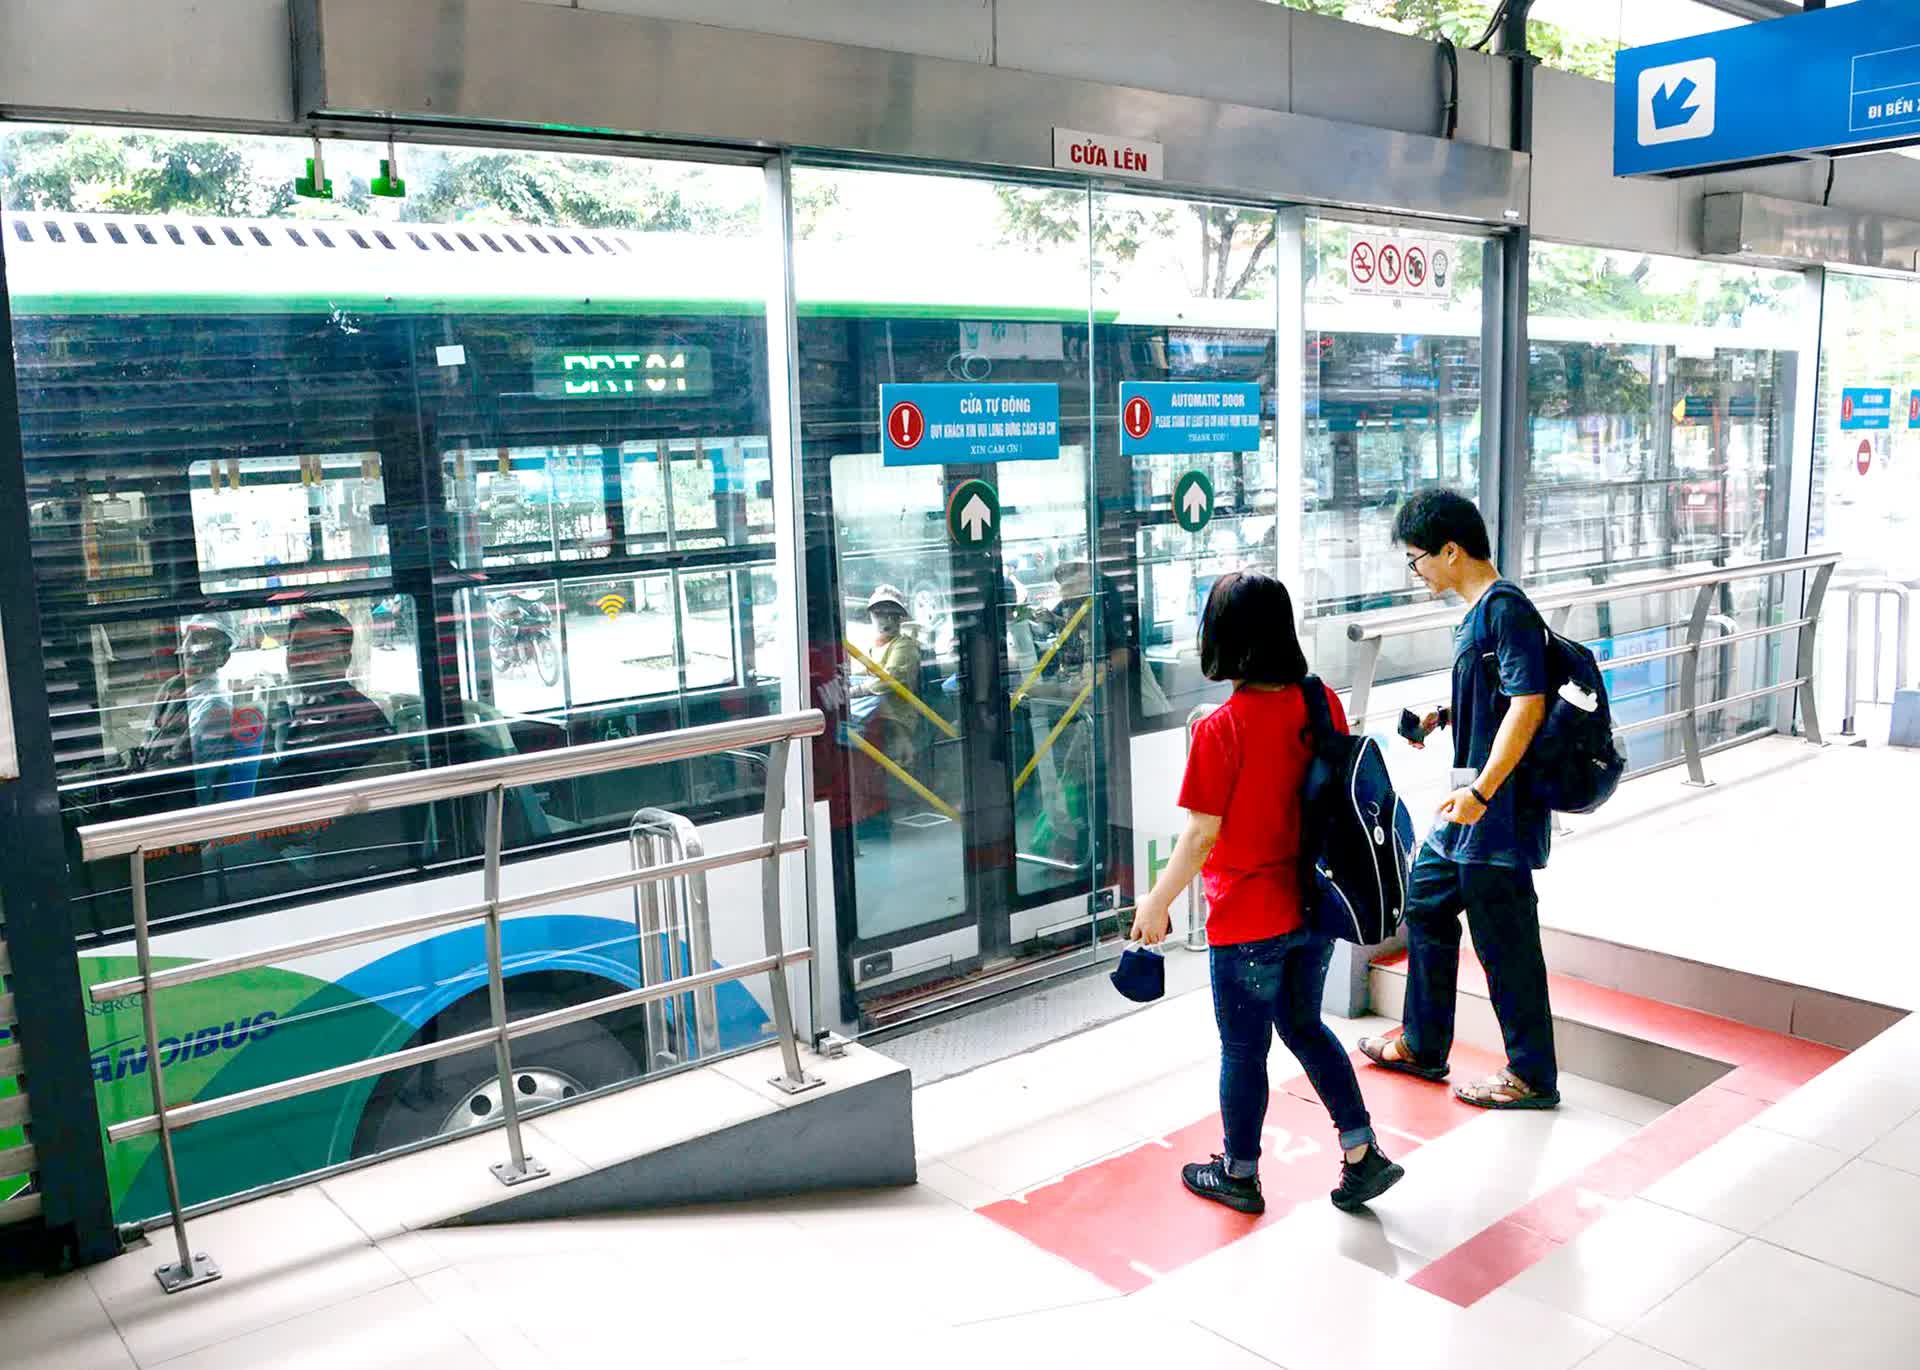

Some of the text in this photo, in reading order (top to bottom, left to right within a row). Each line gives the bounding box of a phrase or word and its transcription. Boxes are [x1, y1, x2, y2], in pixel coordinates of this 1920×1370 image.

[1868, 104, 1882, 119] ĐI
[1886, 96, 1914, 117] BẾN
[1070, 138, 1148, 172] CỬA LÊN
[960, 392, 1031, 417] CỬA TỰ ĐỘNG
[1171, 393, 1245, 408] AUTOMATIC DOOR
[970, 445, 986, 455] XIN
